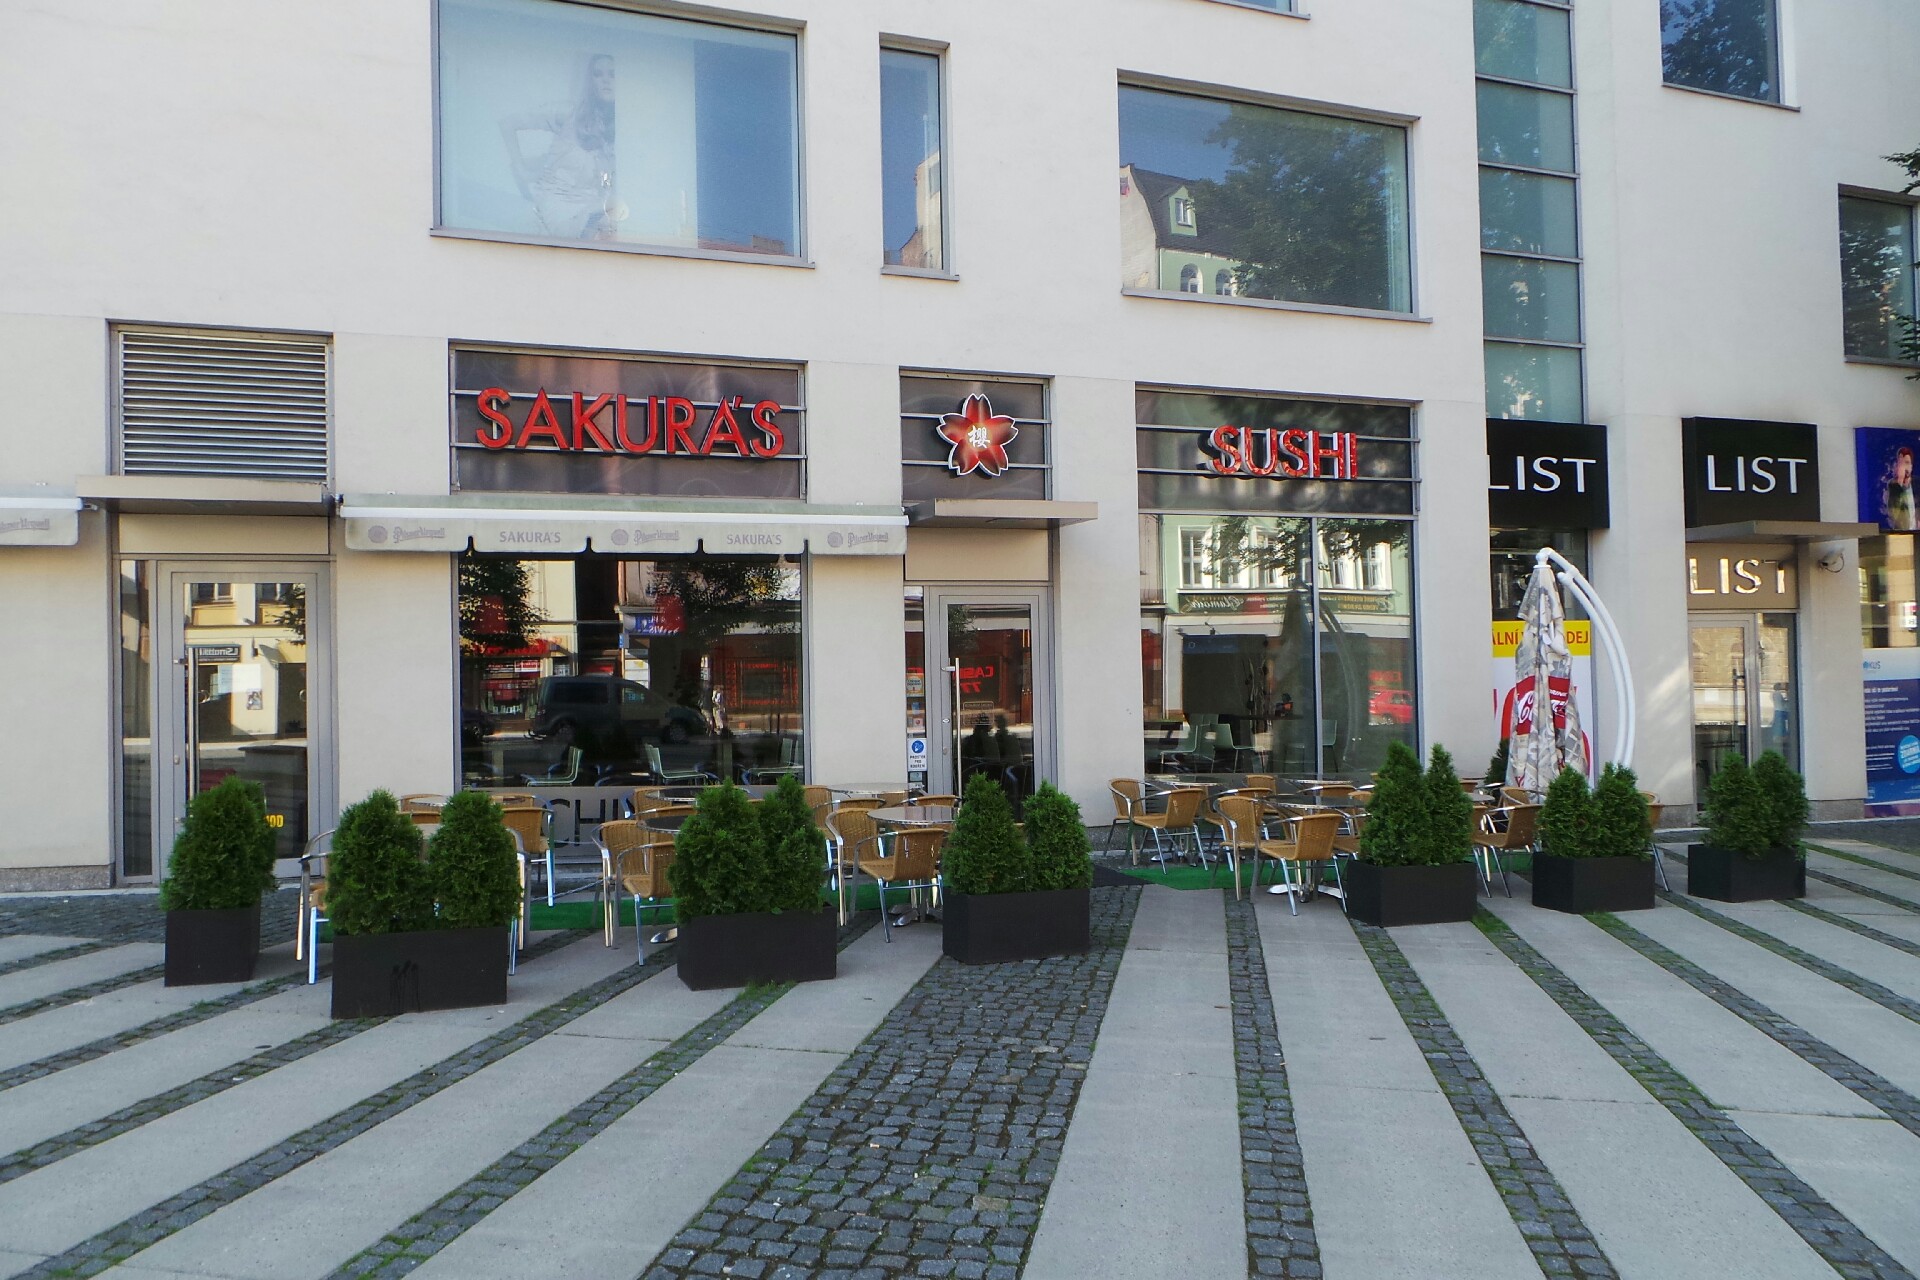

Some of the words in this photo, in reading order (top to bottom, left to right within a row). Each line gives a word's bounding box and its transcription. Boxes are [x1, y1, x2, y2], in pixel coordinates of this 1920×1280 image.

[476, 387, 785, 458] SAKURA'S
[1206, 425, 1359, 479] SUSHI
[1707, 455, 1808, 493] LIST
[1689, 558, 1790, 595] LIST
